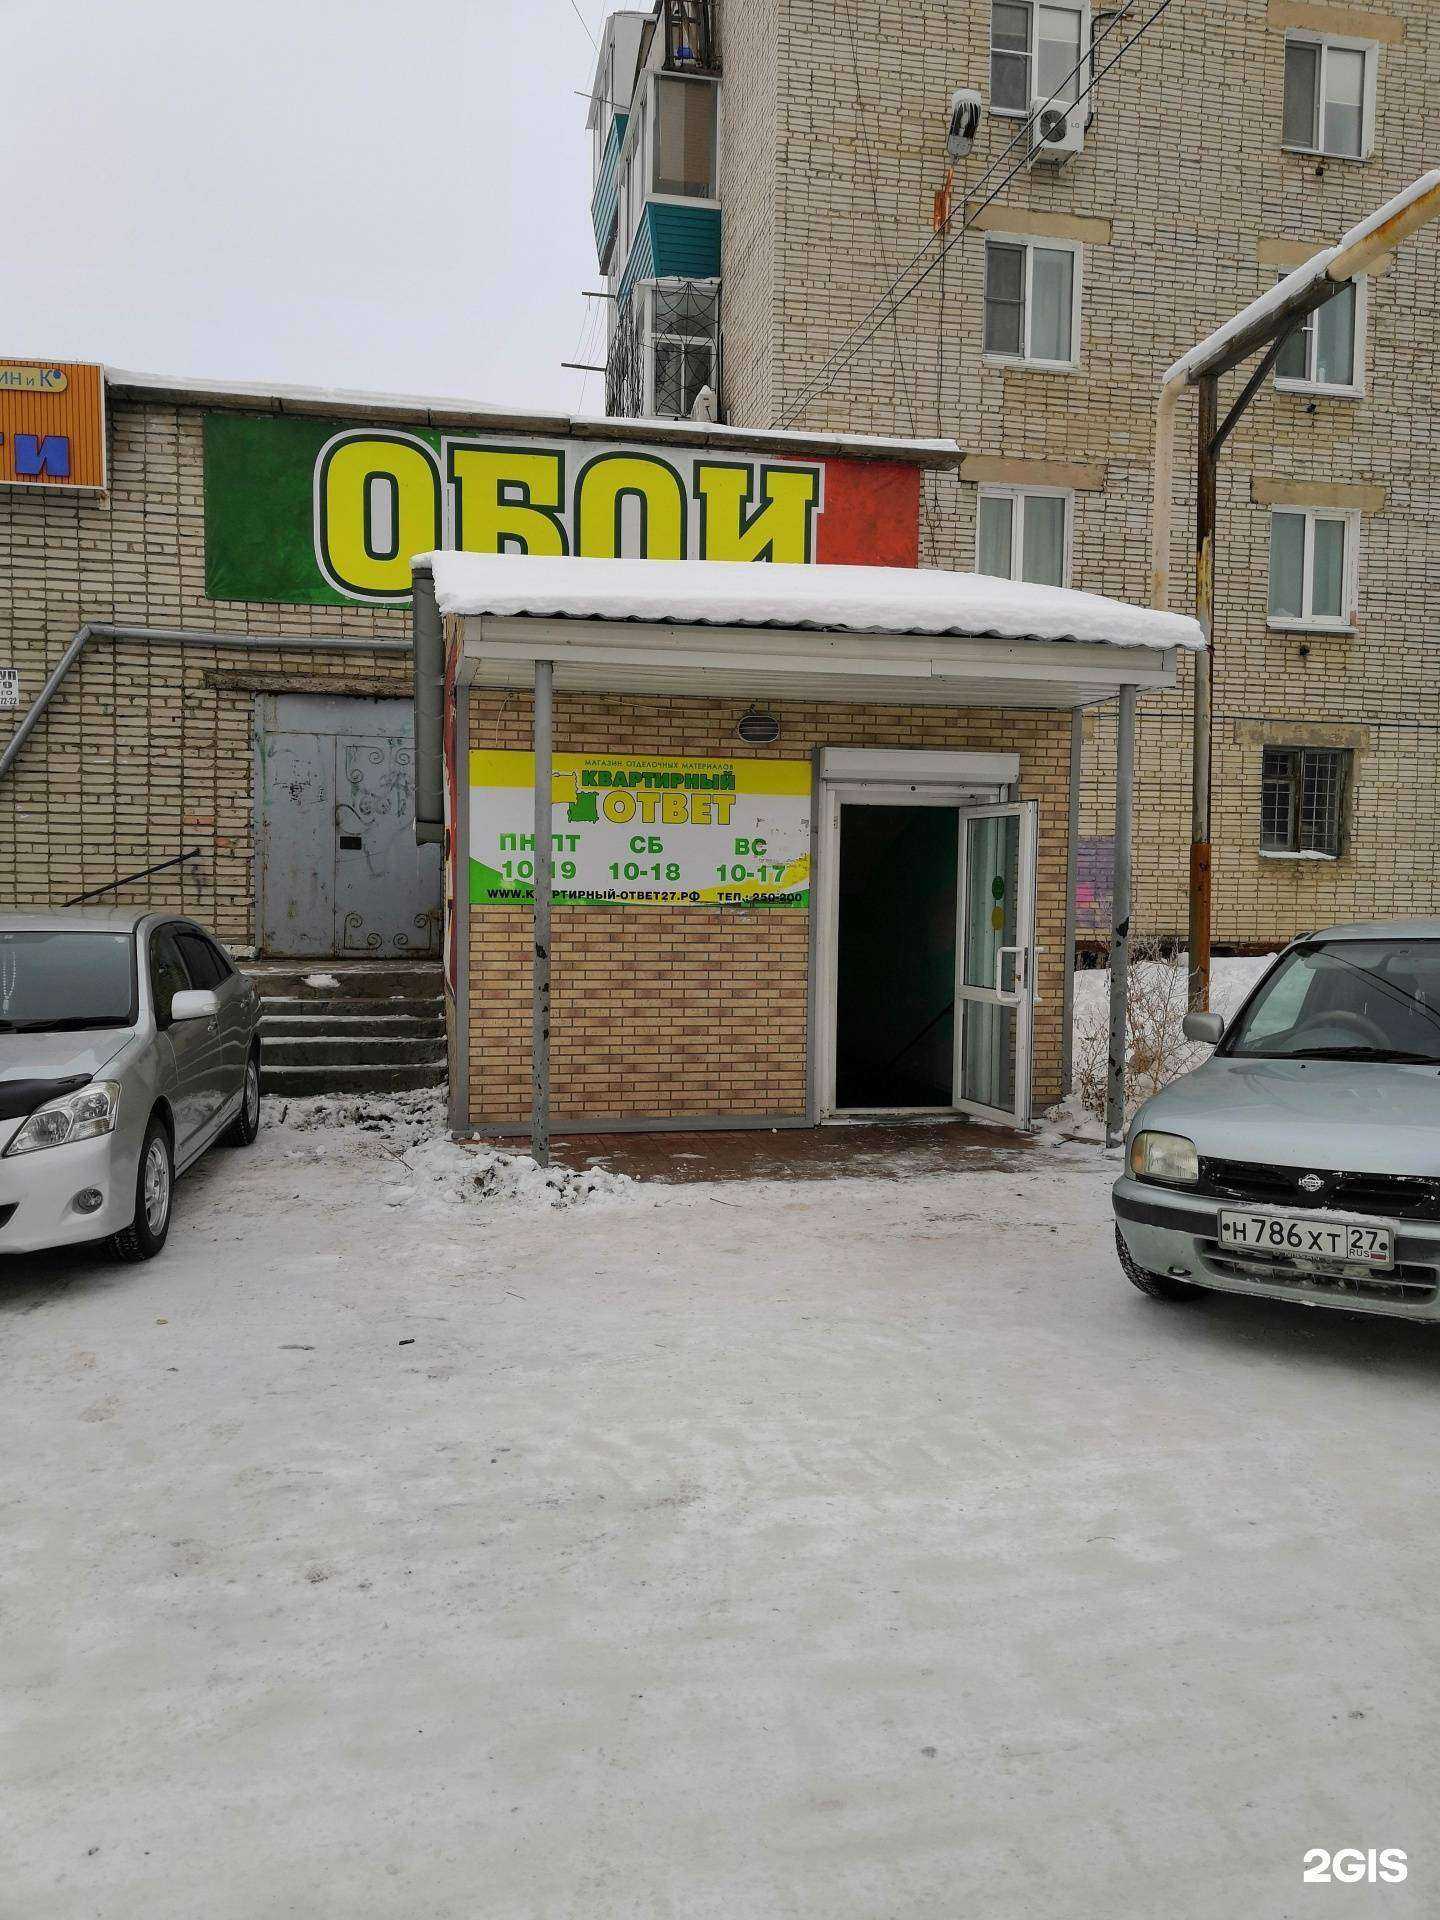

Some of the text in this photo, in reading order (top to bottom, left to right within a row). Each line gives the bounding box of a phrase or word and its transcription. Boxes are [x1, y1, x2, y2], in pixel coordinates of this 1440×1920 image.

[0, 432, 70, 477] И
[314, 430, 823, 602] ОБОИ
[584, 759, 734, 771] МАГАЗИН ОТДЕЛОЧНЫХ МАТЕРИАЛОВ
[581, 769, 736, 791] КВАРТИРНЫЙ
[602, 790, 737, 826] ОТВЕТ
[629, 835, 664, 854] СБ
[734, 837, 768, 856] ВС
[608, 862, 681, 881] 10-18
[716, 864, 786, 882] 10-17
[487, 888, 701, 902] WWW.КРТИРНЫЙ-ОТВЕТ27.РФ
[1232, 1218, 1378, 1253] Н786ХТ 27
[1350, 1248, 1371, 1258] RUS
